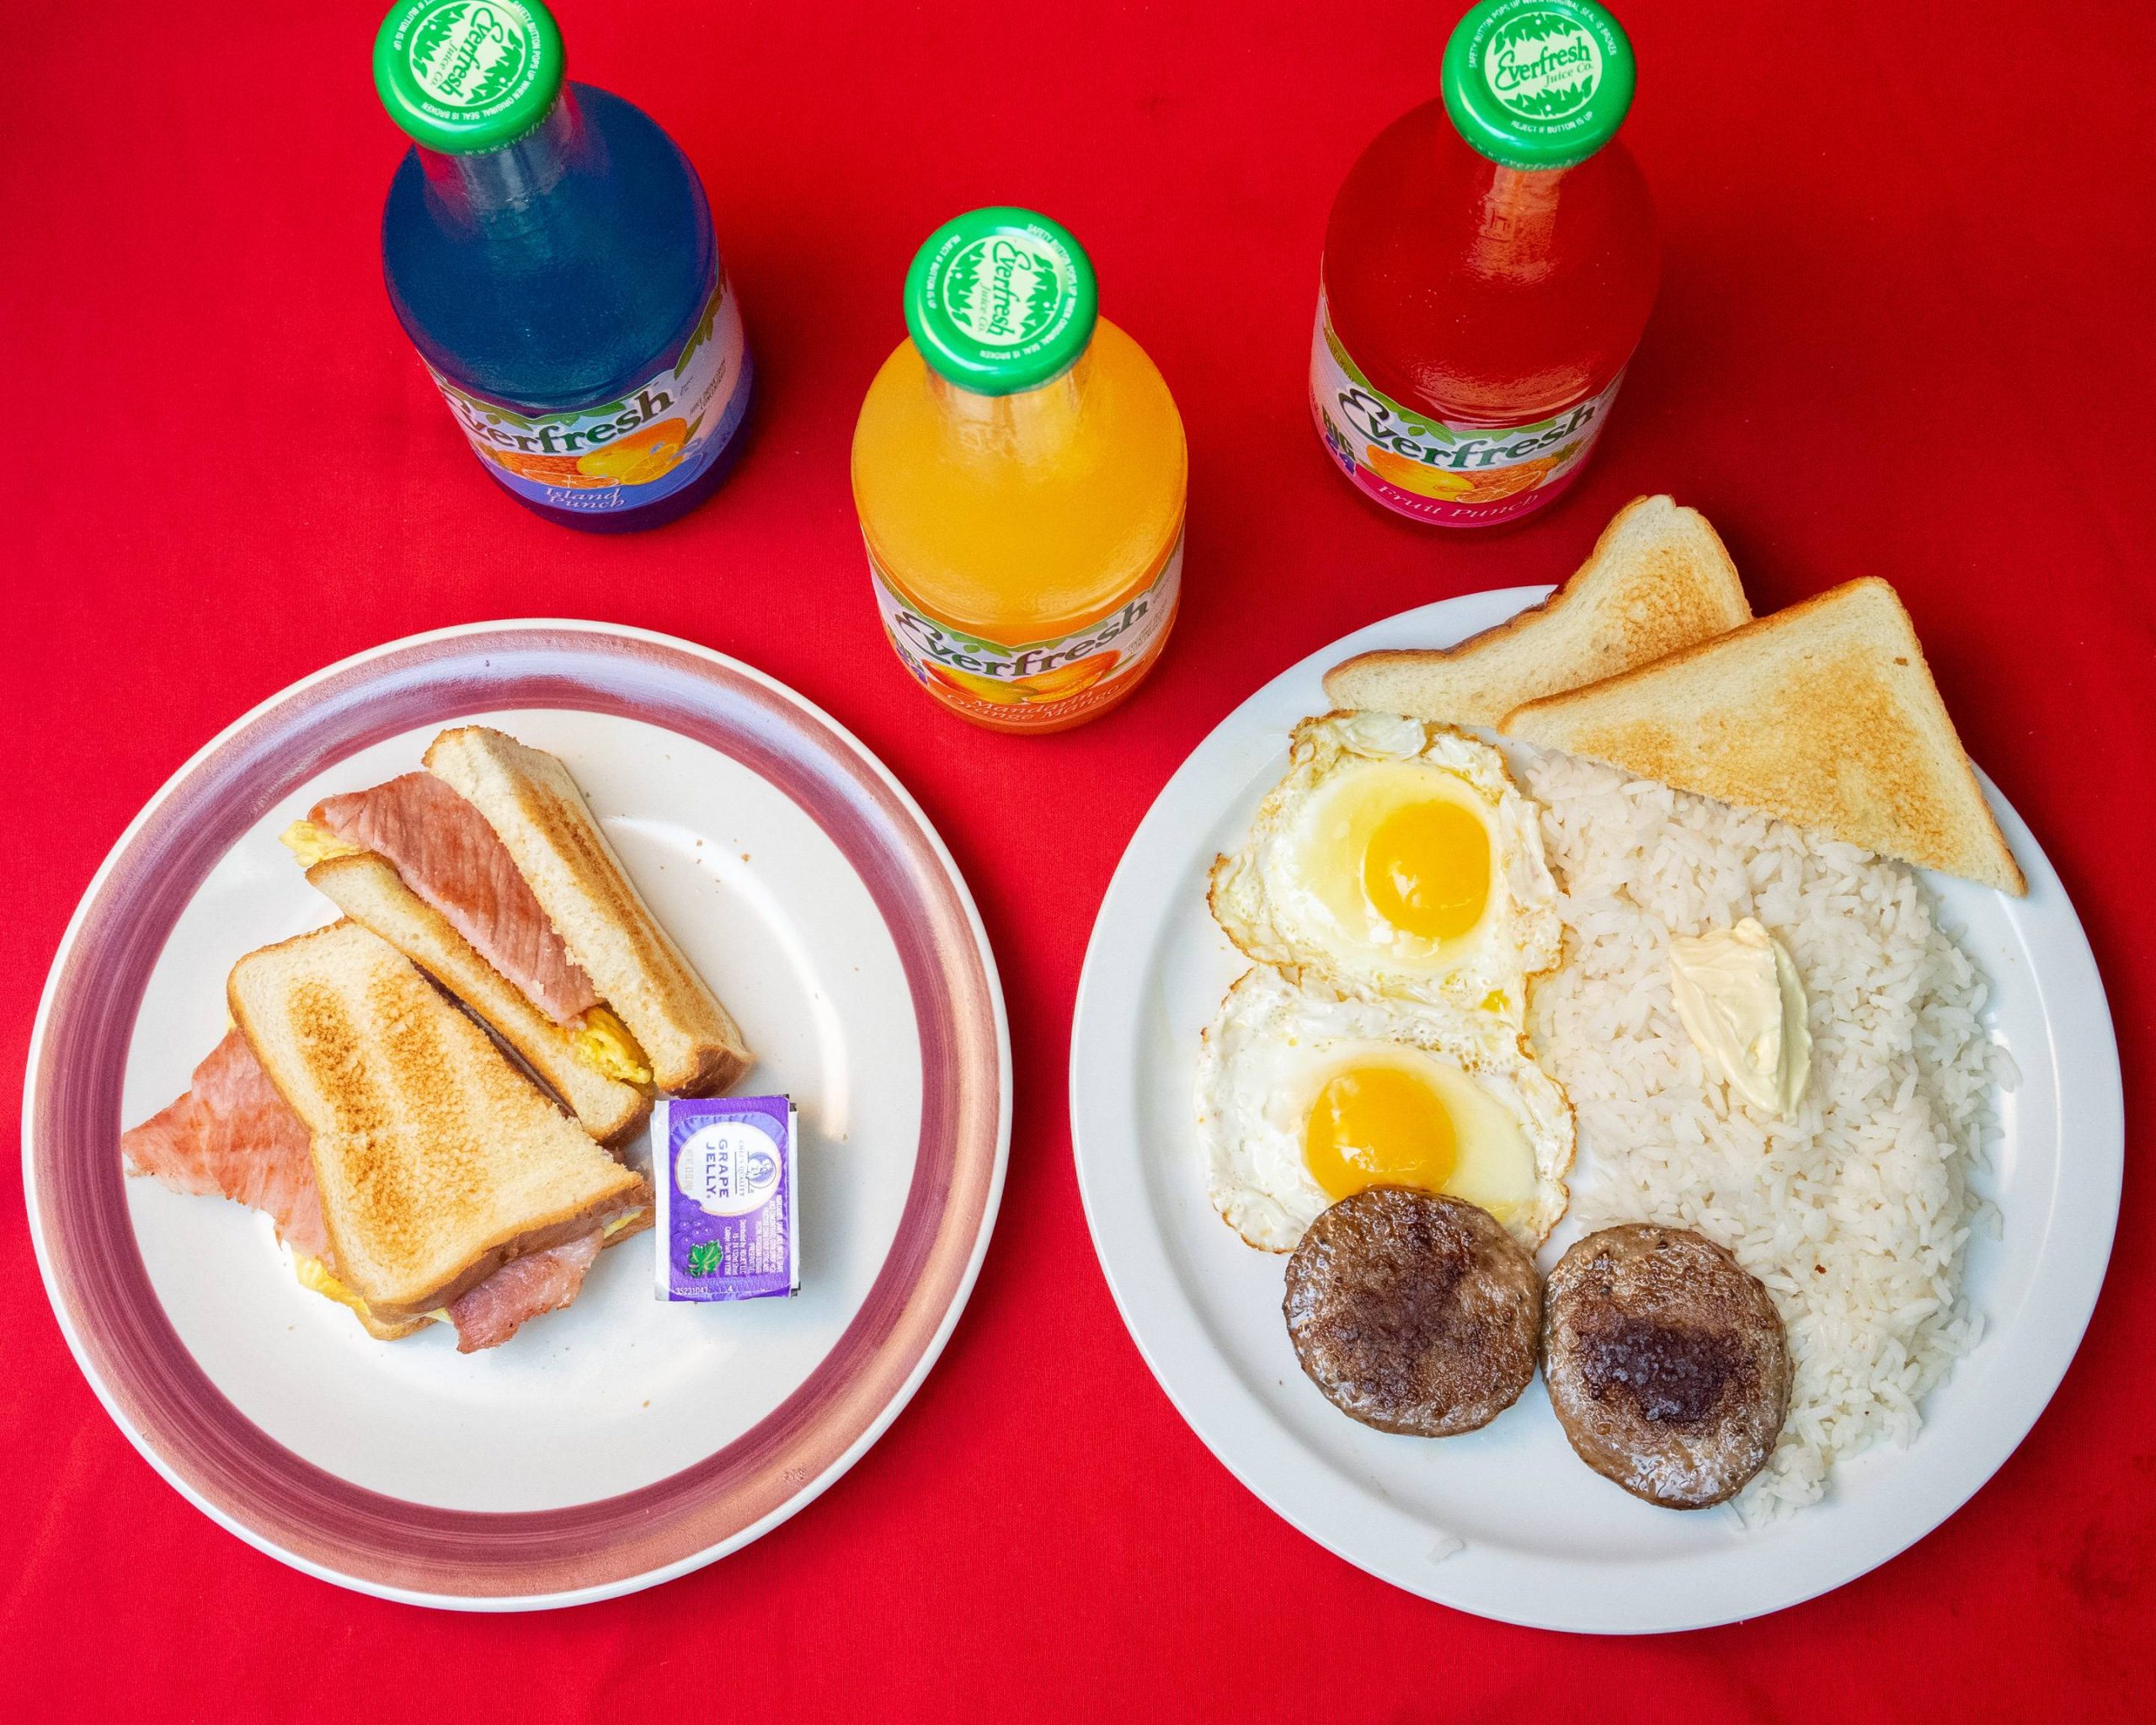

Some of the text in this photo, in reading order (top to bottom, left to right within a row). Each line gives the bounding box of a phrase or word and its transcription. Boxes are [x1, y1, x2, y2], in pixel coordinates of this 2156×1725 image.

[398, 7, 419, 33] BUTTON
[1491, 3, 1511, 19] POPS
[395, 32, 404, 40] IS
[526, 22, 541, 50] BUTTON
[1474, 17, 1494, 42] BUTTON
[1596, 20, 1604, 29] IS
[393, 40, 403, 51] UP
[437, 8, 504, 98] Everfresh
[1599, 27, 1618, 56] BROKEN
[439, 40, 458, 70] Juice
[530, 51, 541, 69] POPS
[1469, 43, 1478, 68] SAFETY
[1495, 35, 1592, 91] Everfresh
[526, 70, 536, 81] UP
[1545, 70, 1574, 88] Juice
[512, 80, 531, 99] WHEN
[421, 102, 450, 120] BROKEN
[451, 112, 459, 120] IS
[462, 112, 480, 120] SEAL
[483, 97, 515, 117] ORIGINAL
[1511, 120, 1537, 133] REJECT
[1547, 122, 1577, 133] BUTTON
[1577, 117, 1584, 126] IS
[1584, 110, 1593, 121] UP
[987, 241, 1032, 336] Everfresh
[1338, 388, 1595, 468] Everfresh
[547, 488, 621, 501] Island
[549, 494, 625, 509] Punch
[1378, 484, 1540, 519] Fruit Punch
[895, 601, 1148, 676] Everfresh
[946, 685, 1120, 722] Orange Mango
[971, 691, 1095, 714] Mandarin
[706, 1142, 716, 1194] JELLY
[719, 1138, 729, 1198] GRAPE
